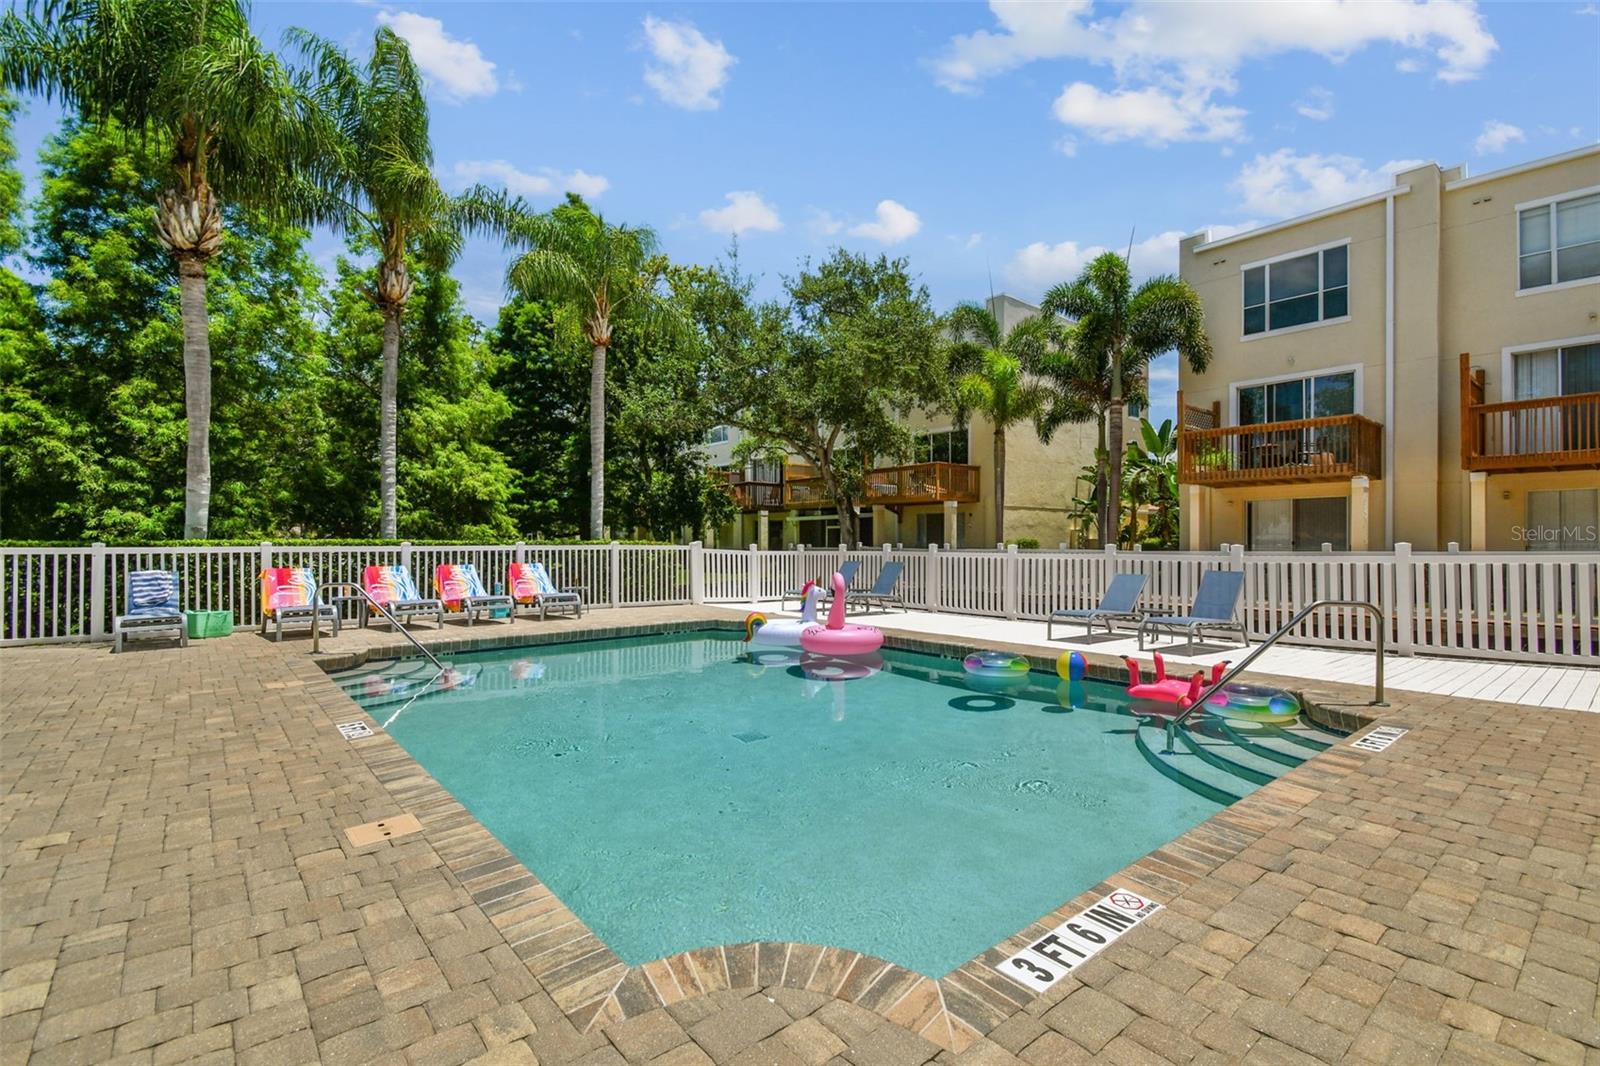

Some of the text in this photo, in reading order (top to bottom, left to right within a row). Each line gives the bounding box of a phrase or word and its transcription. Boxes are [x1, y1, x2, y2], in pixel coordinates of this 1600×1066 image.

[1012, 904, 1137, 982] 3 FT 6 IN
